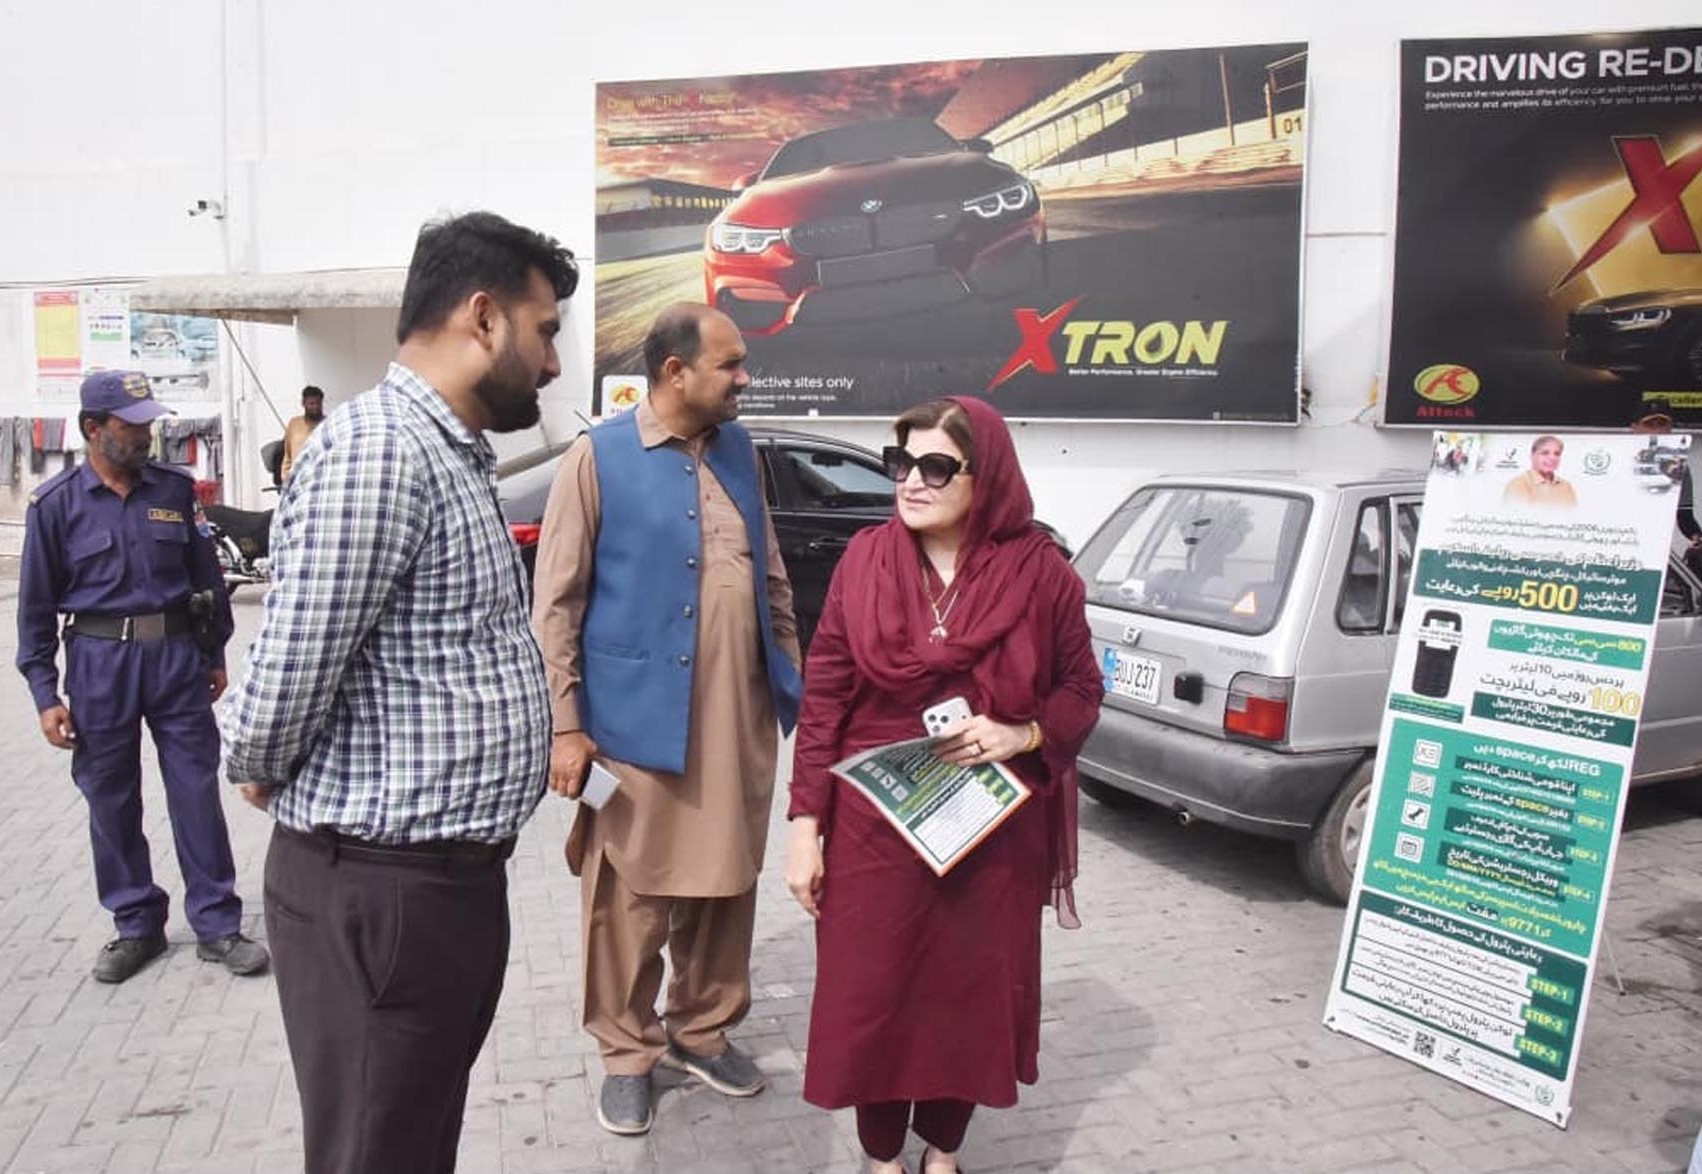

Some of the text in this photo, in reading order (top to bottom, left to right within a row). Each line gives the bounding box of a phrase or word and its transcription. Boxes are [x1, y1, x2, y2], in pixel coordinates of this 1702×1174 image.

[1425, 52, 1586, 83] DRIVING
[1570, 87, 1589, 97] your
[1283, 116, 1302, 134] 01
[987, 295, 1229, 393] XTRON
[794, 376, 823, 388] sites
[826, 376, 853, 390] only
[1519, 580, 1577, 610] 500
[1135, 663, 1156, 690] 237
[1591, 686, 1640, 715] 100
